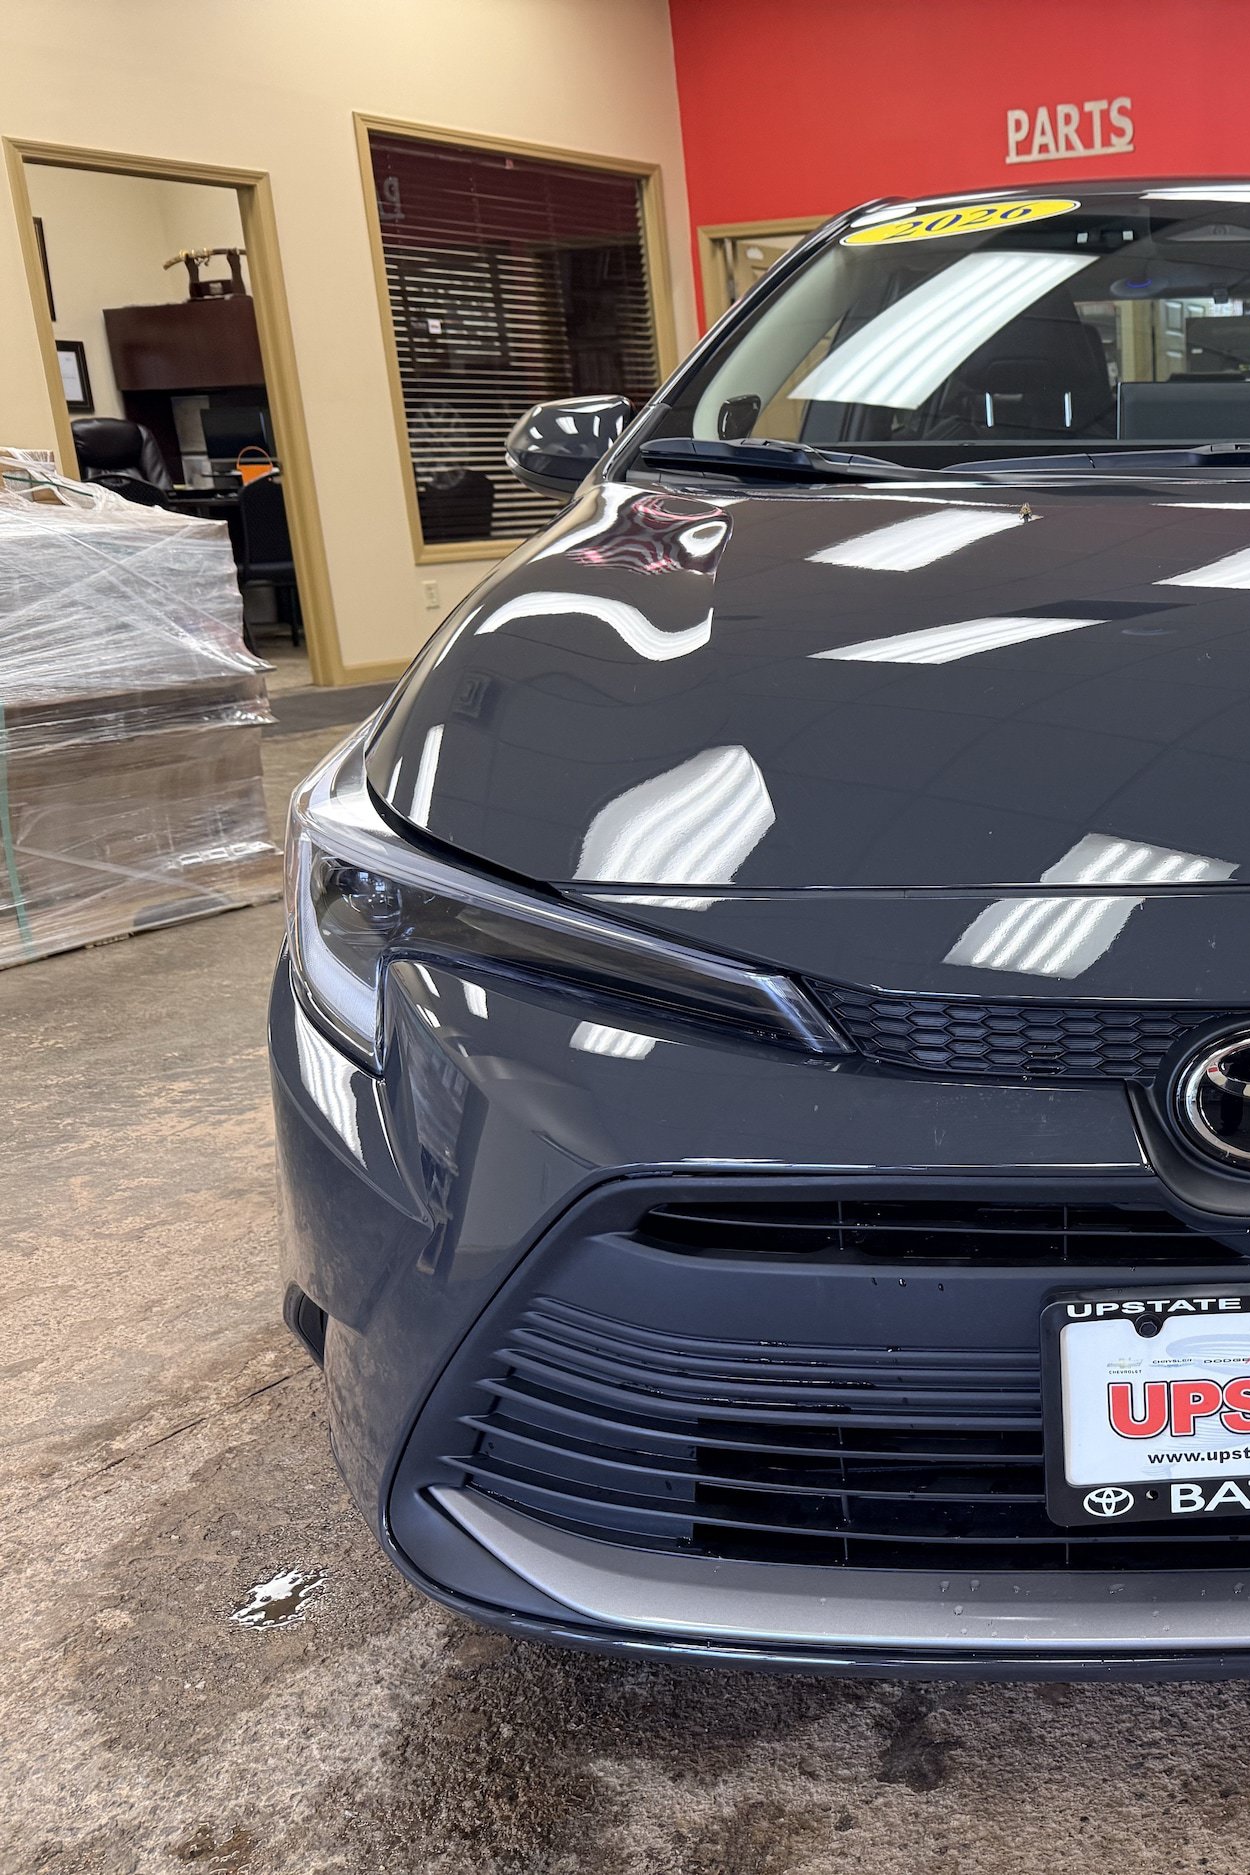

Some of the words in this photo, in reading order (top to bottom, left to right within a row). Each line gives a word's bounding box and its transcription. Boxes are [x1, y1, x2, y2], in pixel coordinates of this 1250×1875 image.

[1006, 97, 1134, 163] PARTS
[881, 202, 1040, 241] 2026
[1066, 1297, 1242, 1318] UPSTATE
